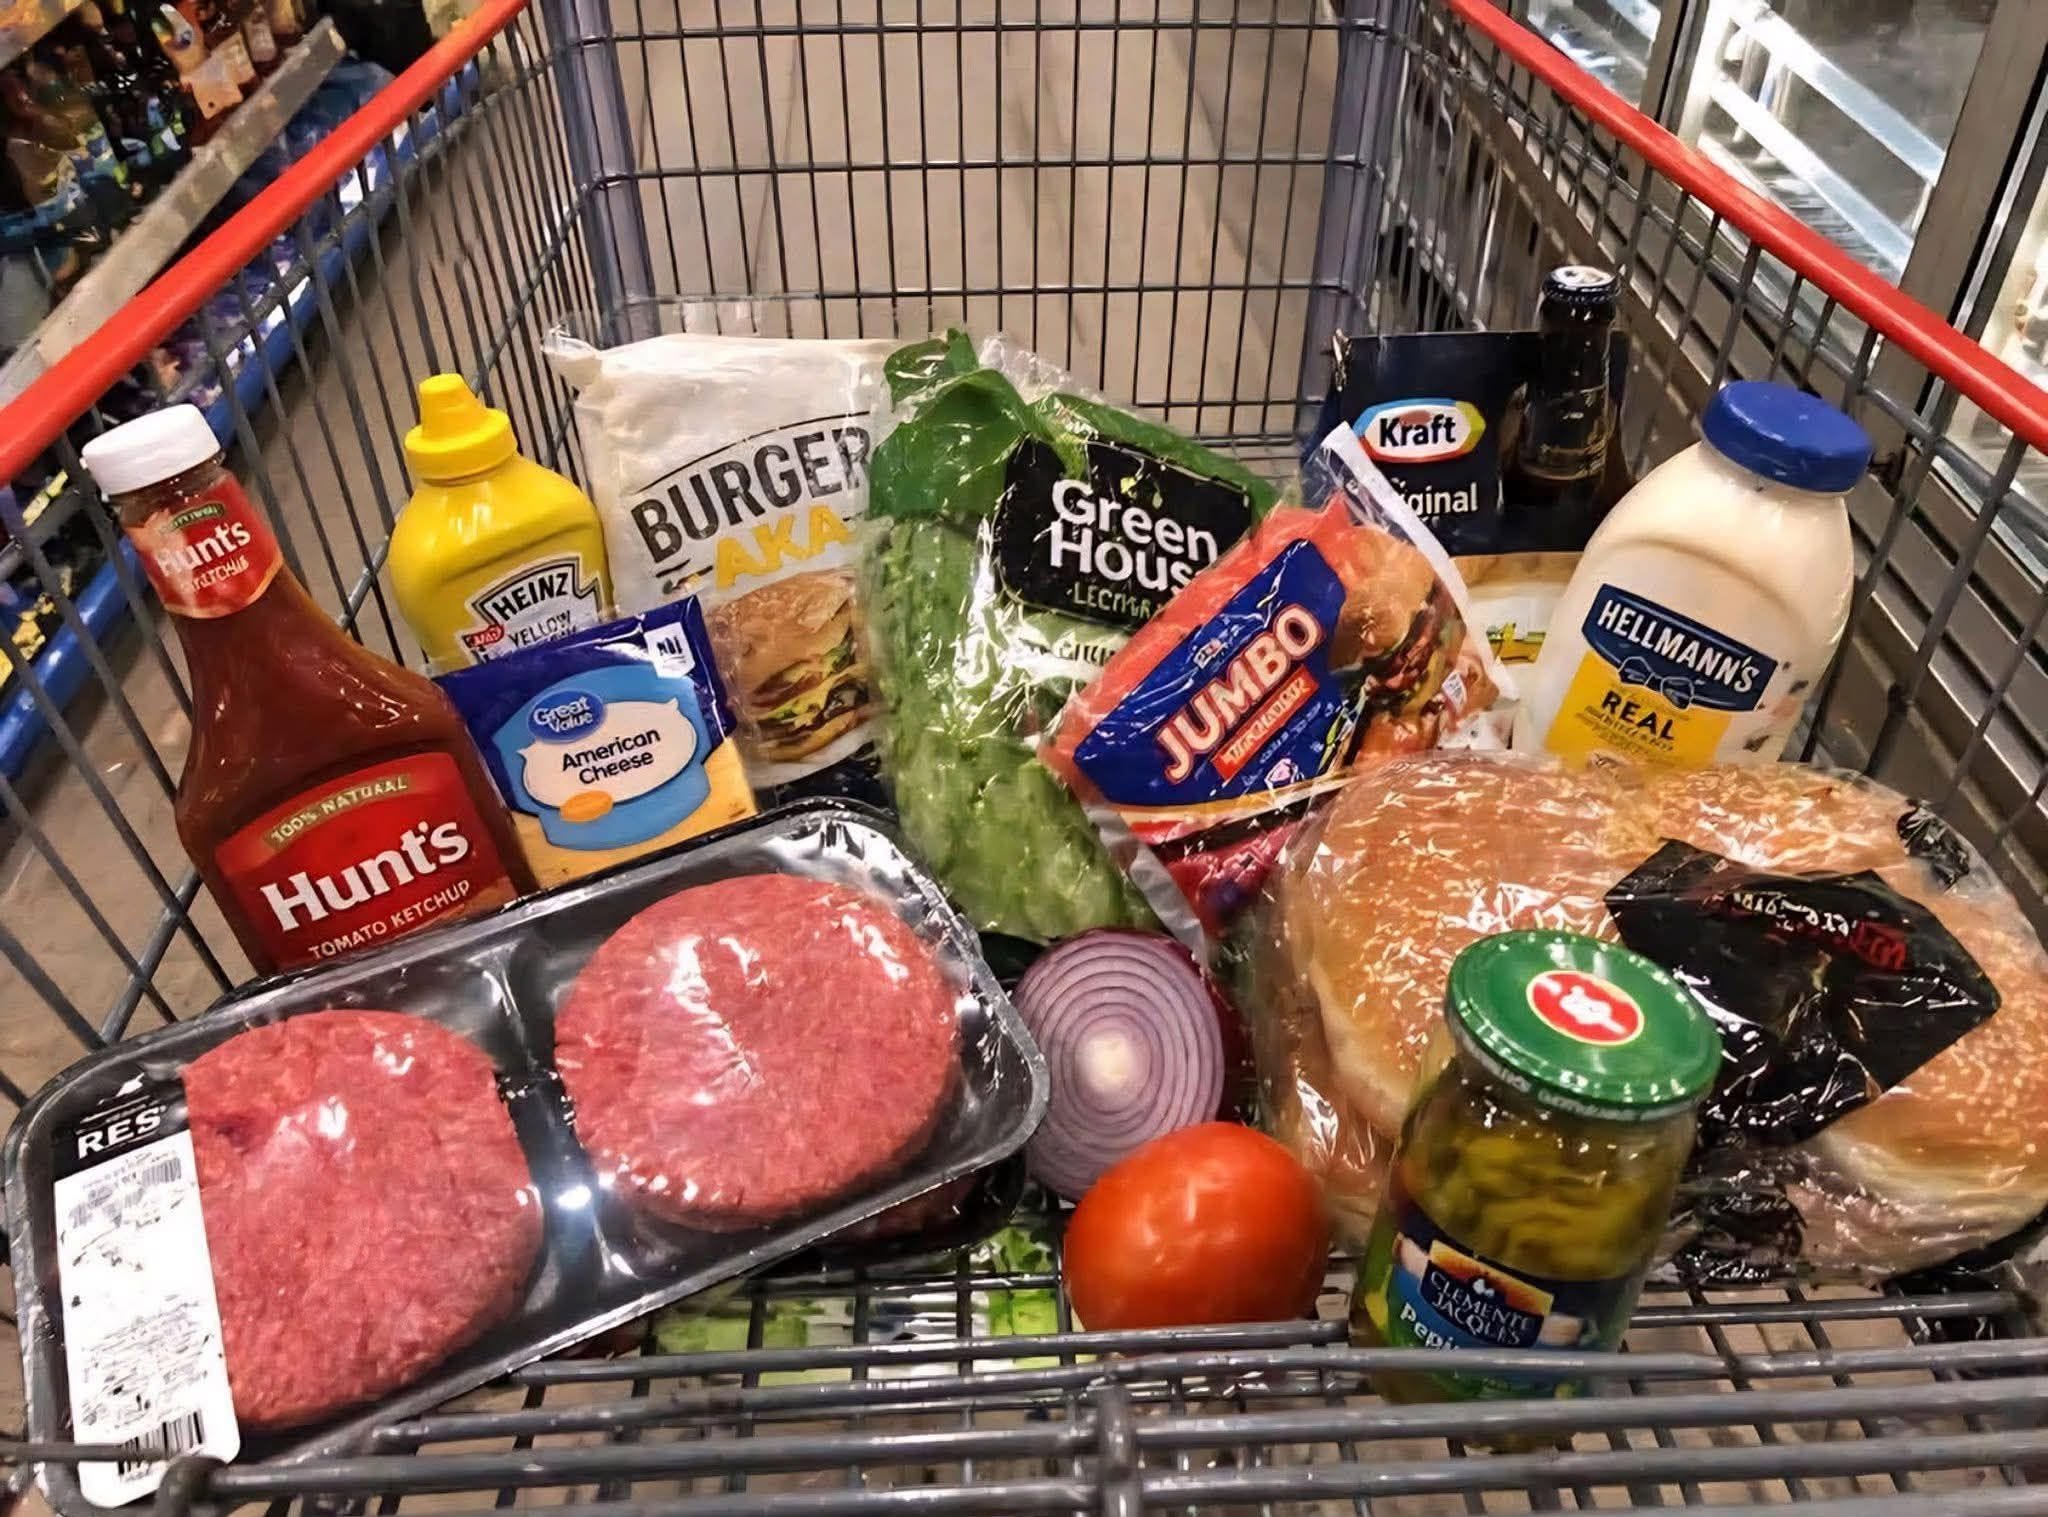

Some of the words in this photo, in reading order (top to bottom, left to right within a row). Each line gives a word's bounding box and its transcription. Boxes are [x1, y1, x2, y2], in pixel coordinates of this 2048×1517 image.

[1379, 413, 1457, 448] Kraft
[630, 426, 871, 564] BURGER
[1051, 478, 1218, 566] Green
[1049, 520, 1203, 596] Hous
[492, 572, 570, 622] HEINZ
[508, 610, 572, 648] YELLOW
[1597, 599, 1760, 694] HELLMANN'S
[533, 695, 591, 726] Great
[1156, 602, 1327, 787] JUMBO
[1601, 690, 1675, 741] REAL
[548, 710, 594, 733] Value
[562, 729, 661, 772] American
[578, 751, 655, 785] Cheese
[271, 810, 318, 843] 100%
[259, 820, 469, 932] Hunt's
[308, 920, 388, 960] TOMATO
[390, 879, 471, 929] KETCHUP
[77, 1107, 161, 1160] RES
